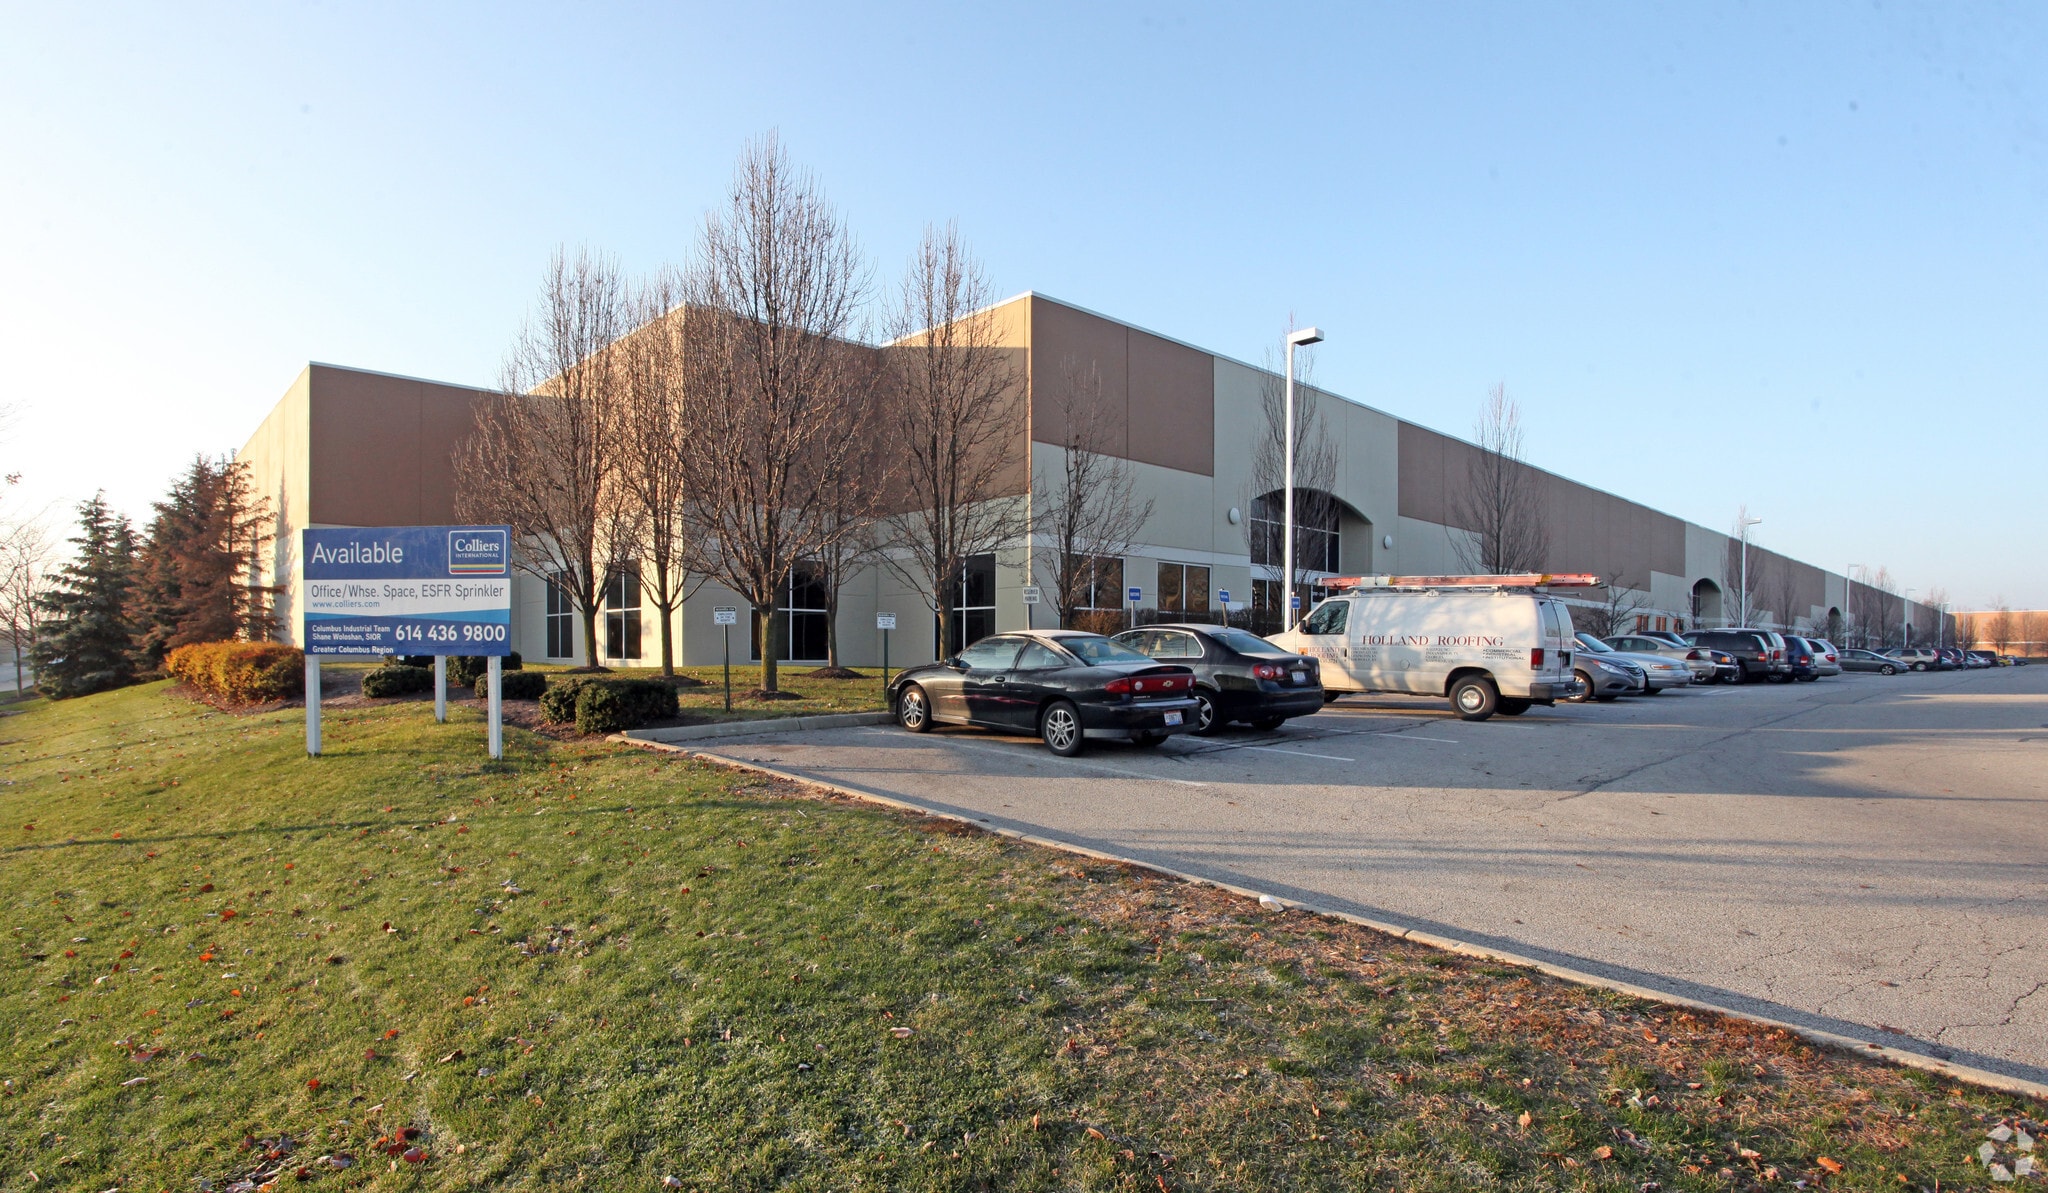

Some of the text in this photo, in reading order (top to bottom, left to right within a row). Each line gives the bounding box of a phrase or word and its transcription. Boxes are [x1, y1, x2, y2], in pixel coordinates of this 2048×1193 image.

[311, 541, 403, 564] Available
[455, 539, 499, 552] Colliers
[311, 584, 504, 600] Office/Whse. Space, ESFR Sprinkler
[396, 625, 505, 642] 614 436 9800
[1362, 635, 1504, 646] HOLLAND ROOFING
